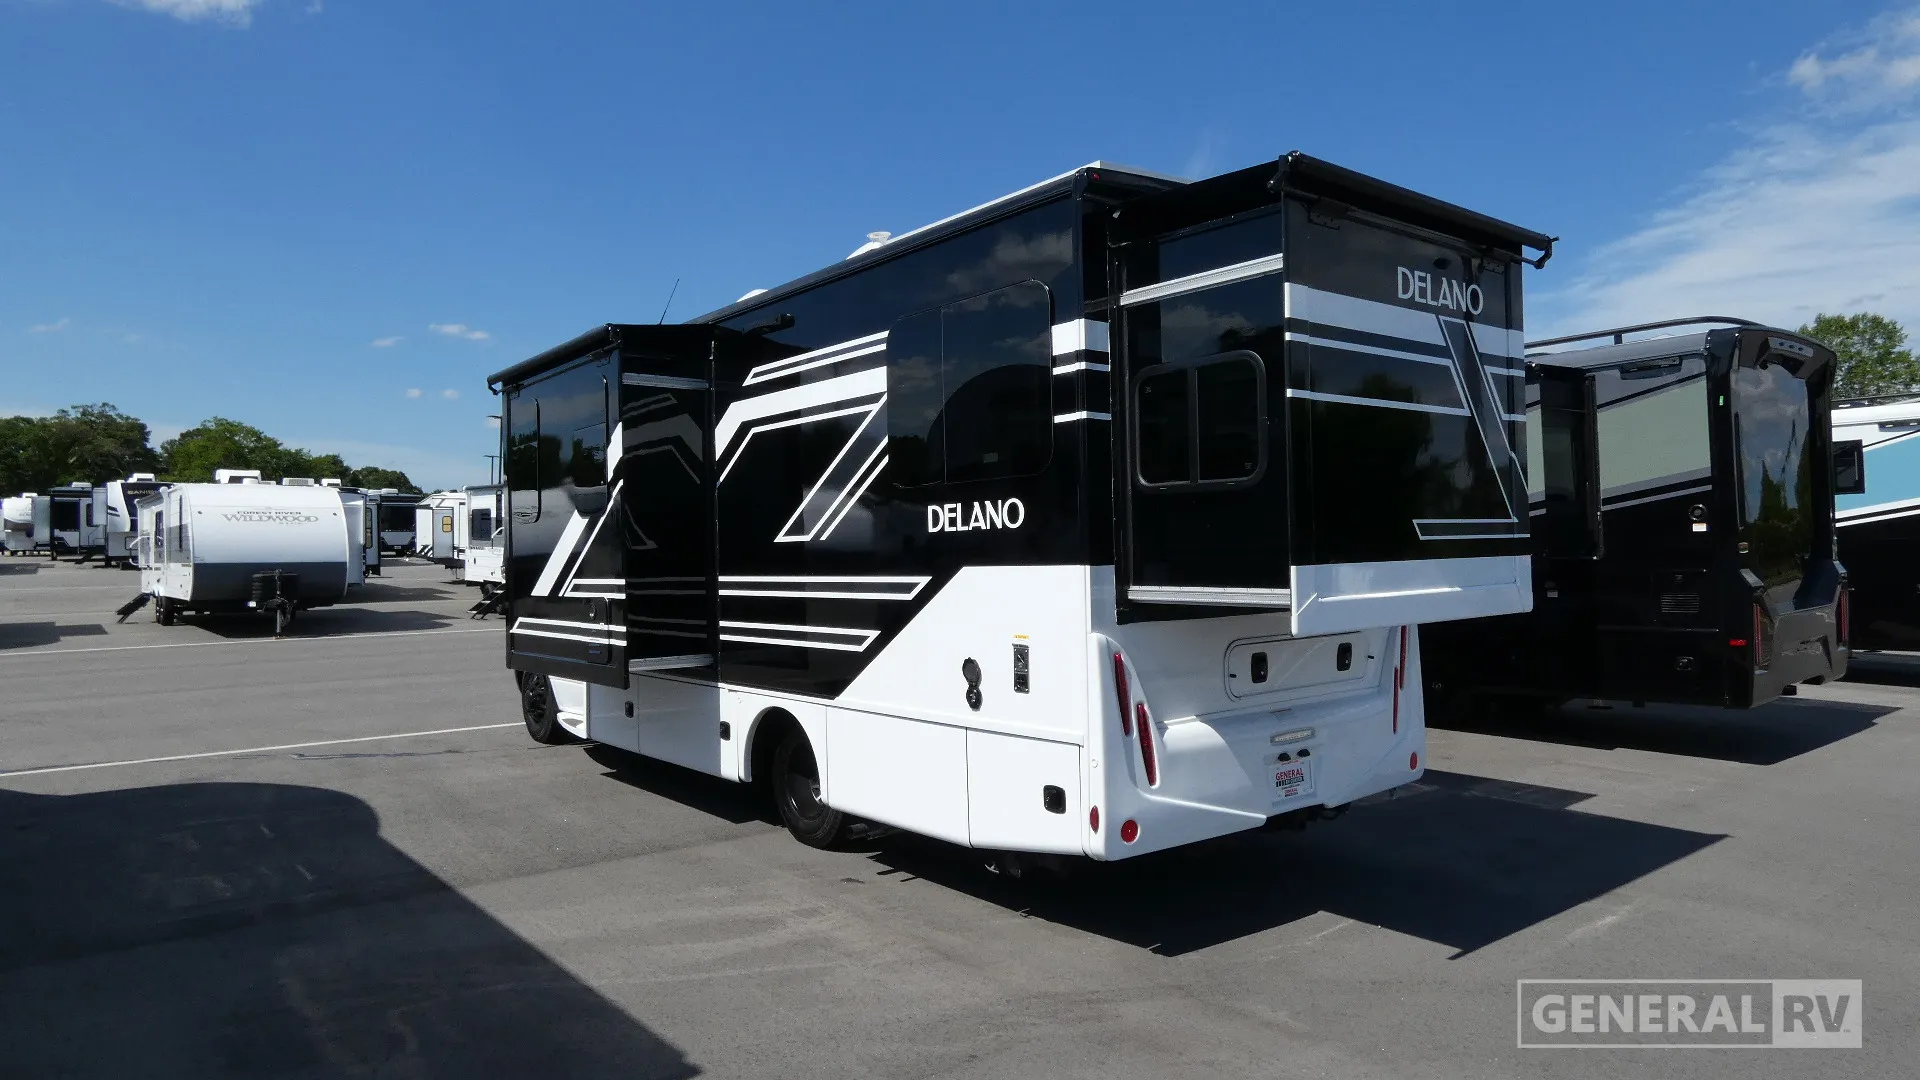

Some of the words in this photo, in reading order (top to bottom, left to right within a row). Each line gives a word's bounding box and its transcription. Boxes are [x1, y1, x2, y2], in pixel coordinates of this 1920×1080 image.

[1397, 266, 1484, 315] DELANO
[221, 513, 319, 523] WILDWOOD
[928, 497, 1025, 533] DELANO
[1275, 768, 1304, 781] GENERAL
